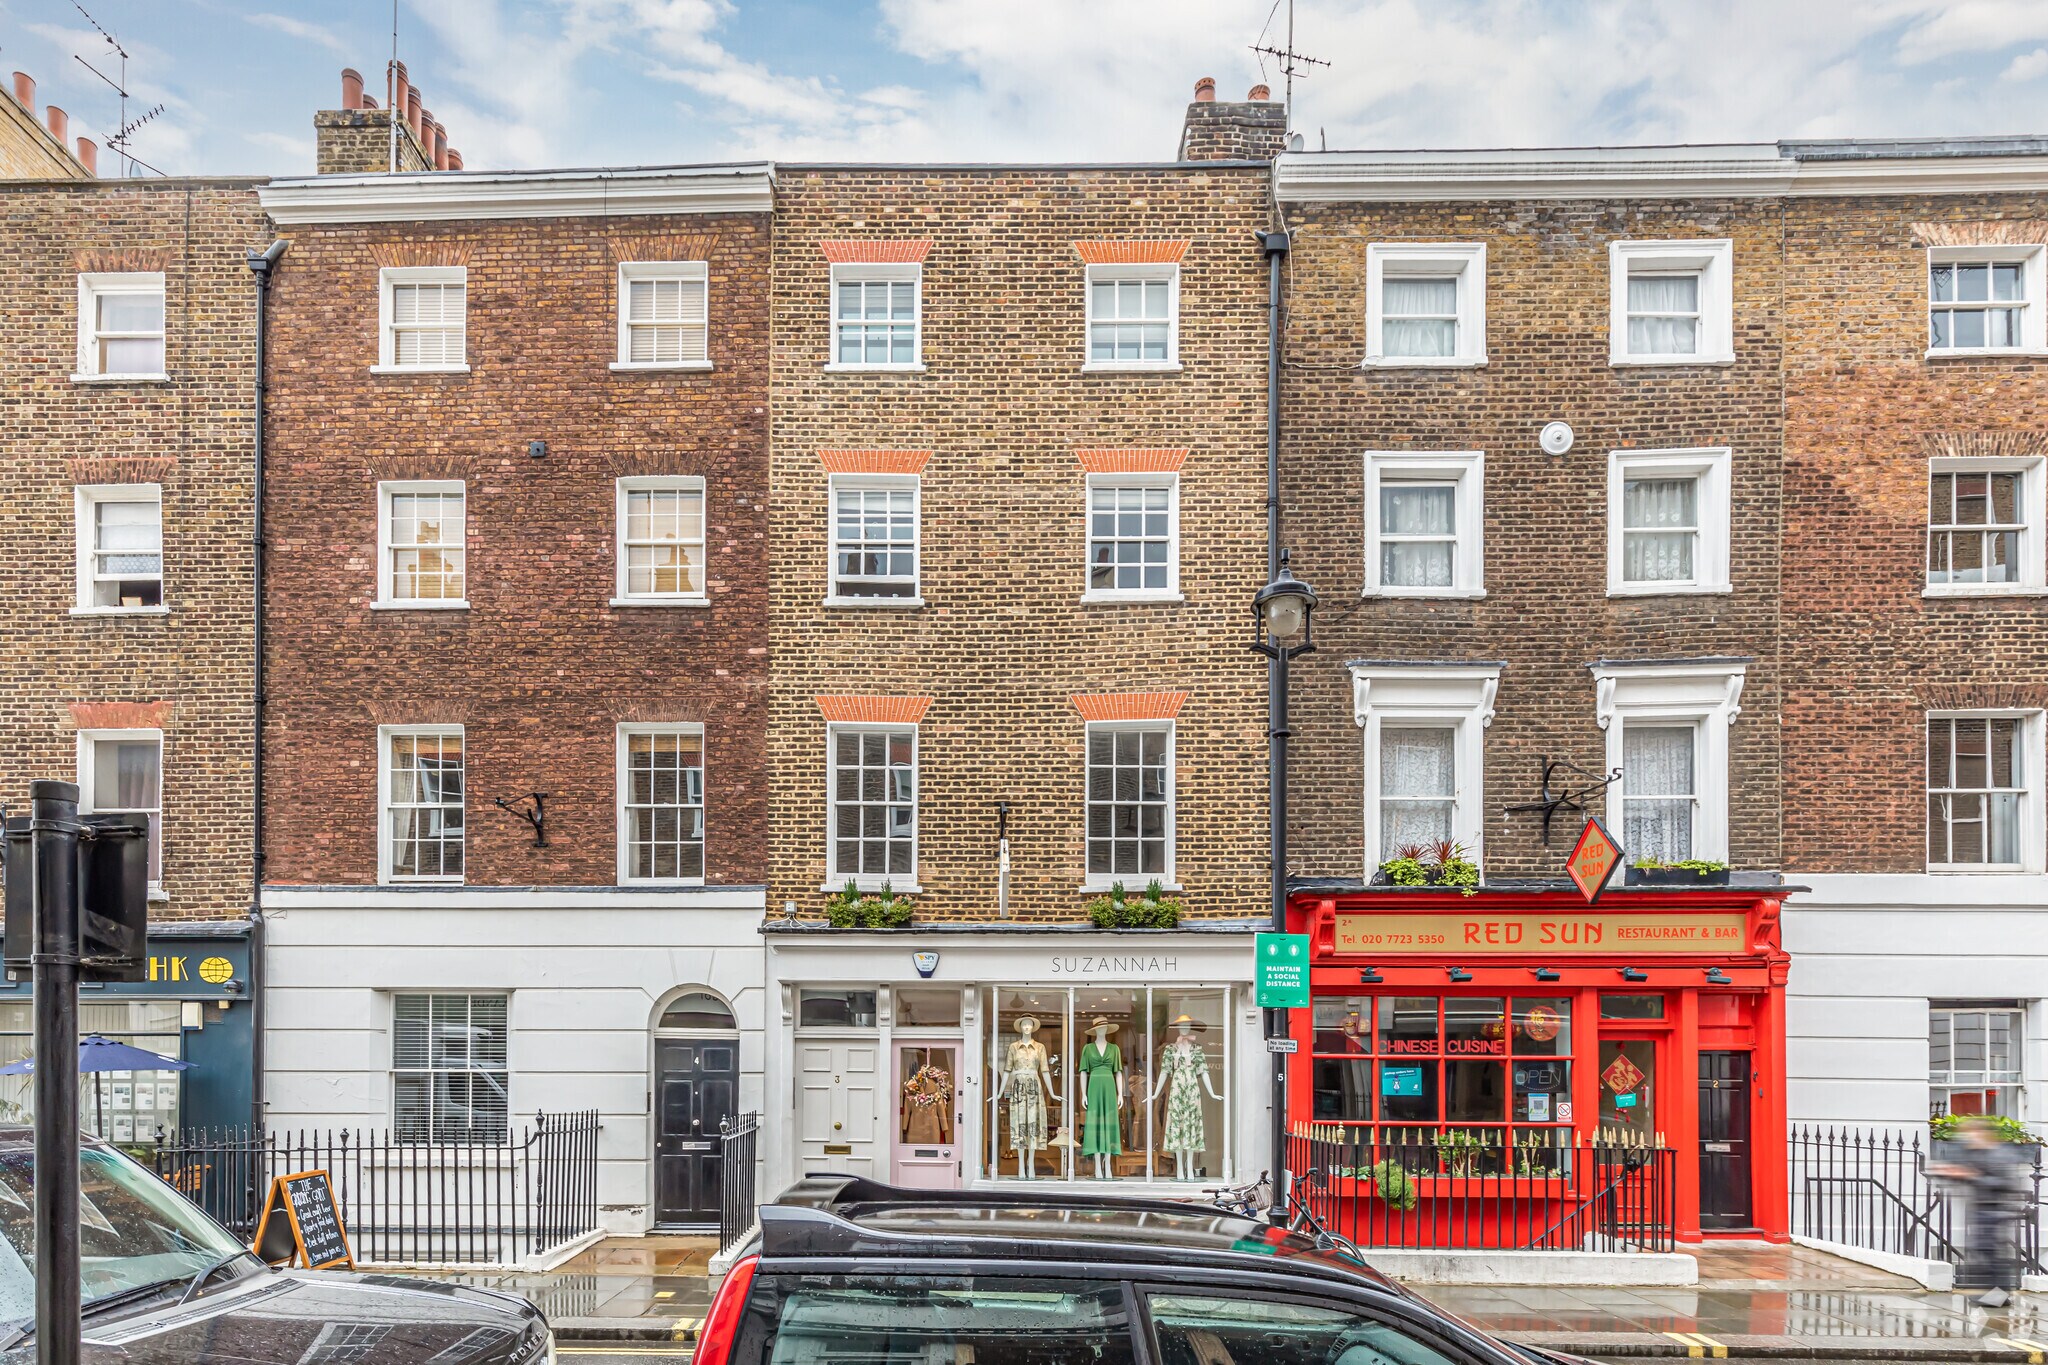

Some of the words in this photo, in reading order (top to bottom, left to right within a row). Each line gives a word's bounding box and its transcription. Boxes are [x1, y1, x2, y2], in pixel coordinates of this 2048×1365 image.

[1582, 843, 1604, 860] RED
[1581, 861, 1604, 879] SUN
[1341, 934, 1357, 944] Tel.
[1362, 934, 1382, 944] 020
[1386, 934, 1413, 944] 7723
[1418, 934, 1445, 944] 5350
[1463, 922, 1523, 944] RED
[1539, 922, 1603, 944] SUN
[1617, 927, 1697, 939] RESTAURANT
[1701, 927, 1710, 939] &
[1714, 927, 1739, 939] BAR
[1051, 957, 1177, 973] SUZANNAH
[1266, 965, 1301, 973] MAINTAIN
[1266, 980, 1301, 988] DISTANCE
[1378, 1040, 1439, 1053] CHINESE
[1447, 1040, 1504, 1054] CUISINE
[694, 1056, 700, 1065] 4
[834, 1075, 841, 1084] 3
[966, 1076, 972, 1084] 3
[1277, 1073, 1284, 1082] 5
[1515, 1069, 1562, 1085] OPEN
[1712, 1079, 1719, 1088] 2
[298, 1178, 313, 1192] THE
[509, 1331, 543, 1363] ROVER
